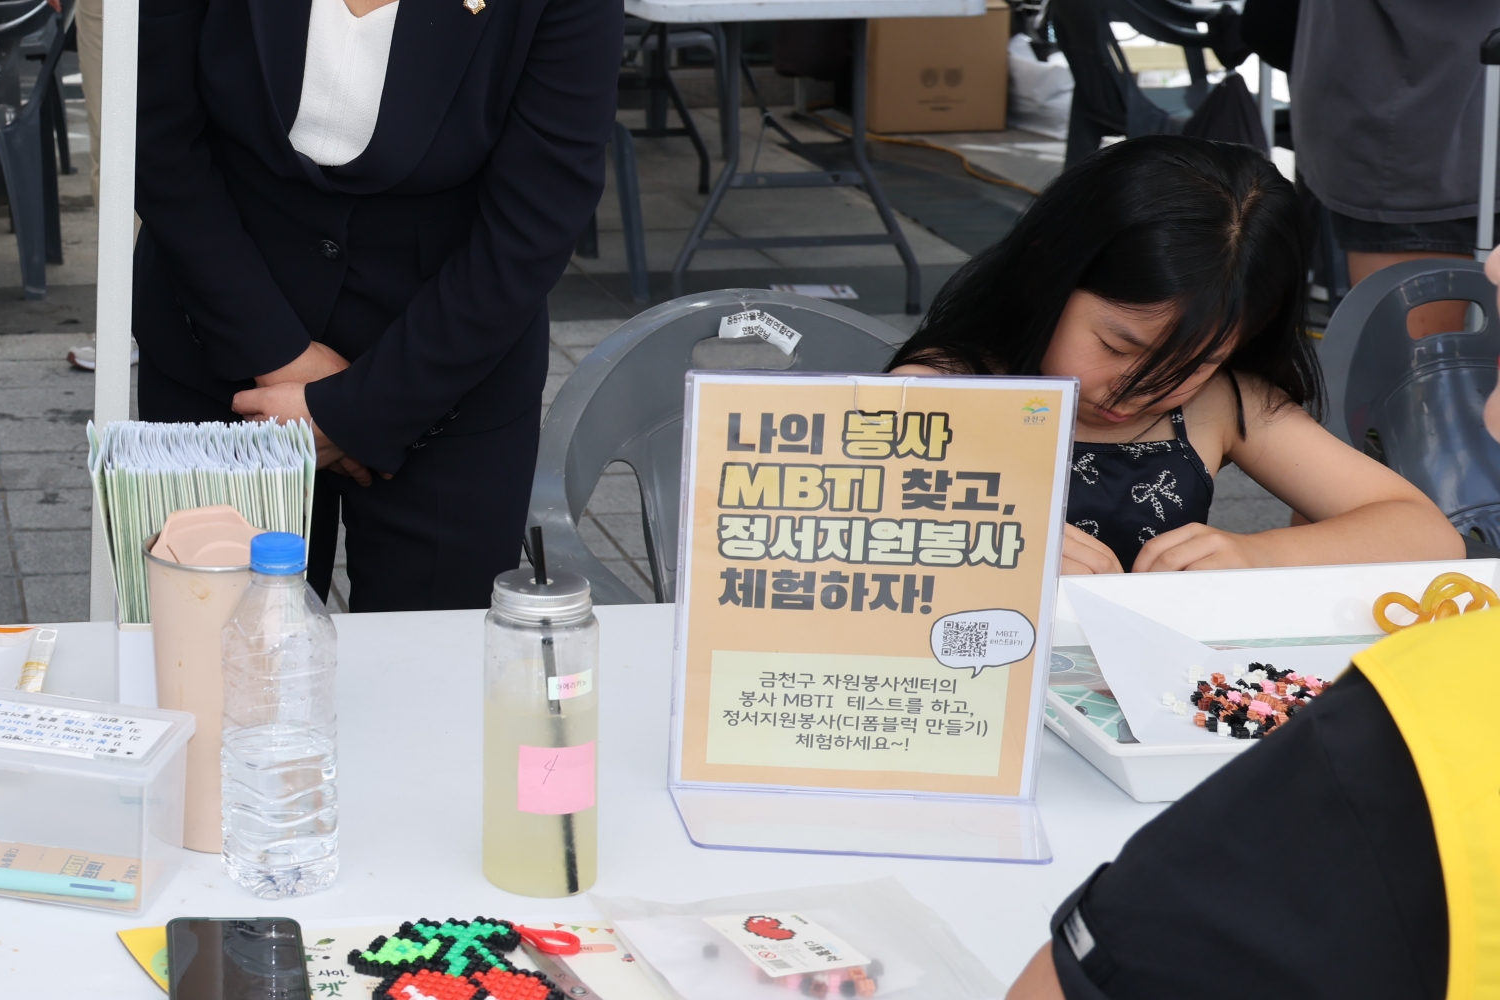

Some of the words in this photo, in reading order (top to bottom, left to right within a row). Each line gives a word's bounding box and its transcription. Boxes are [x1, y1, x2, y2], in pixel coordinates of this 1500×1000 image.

[726, 412, 826, 455] 나의
[842, 410, 953, 461] 봉사
[717, 461, 885, 513] MBTI
[901, 468, 1016, 515] 찾고,
[717, 513, 1024, 569] 정서지원봉사
[717, 567, 935, 615] 체험하자!
[989, 638, 1023, 646] 테스트하기
[758, 671, 816, 689] 금천구
[822, 674, 957, 695] 자원봉사센터의
[738, 691, 777, 708] 봉사
[783, 693, 833, 709] MBTI
[846, 695, 924, 715] 테스트를
[931, 699, 975, 719] 하고,
[722, 709, 919, 735] 정서지원봉사(디폼블럭
[925, 718, 989, 738] 만들기)
[795, 733, 911, 752] 체험하세요~!
